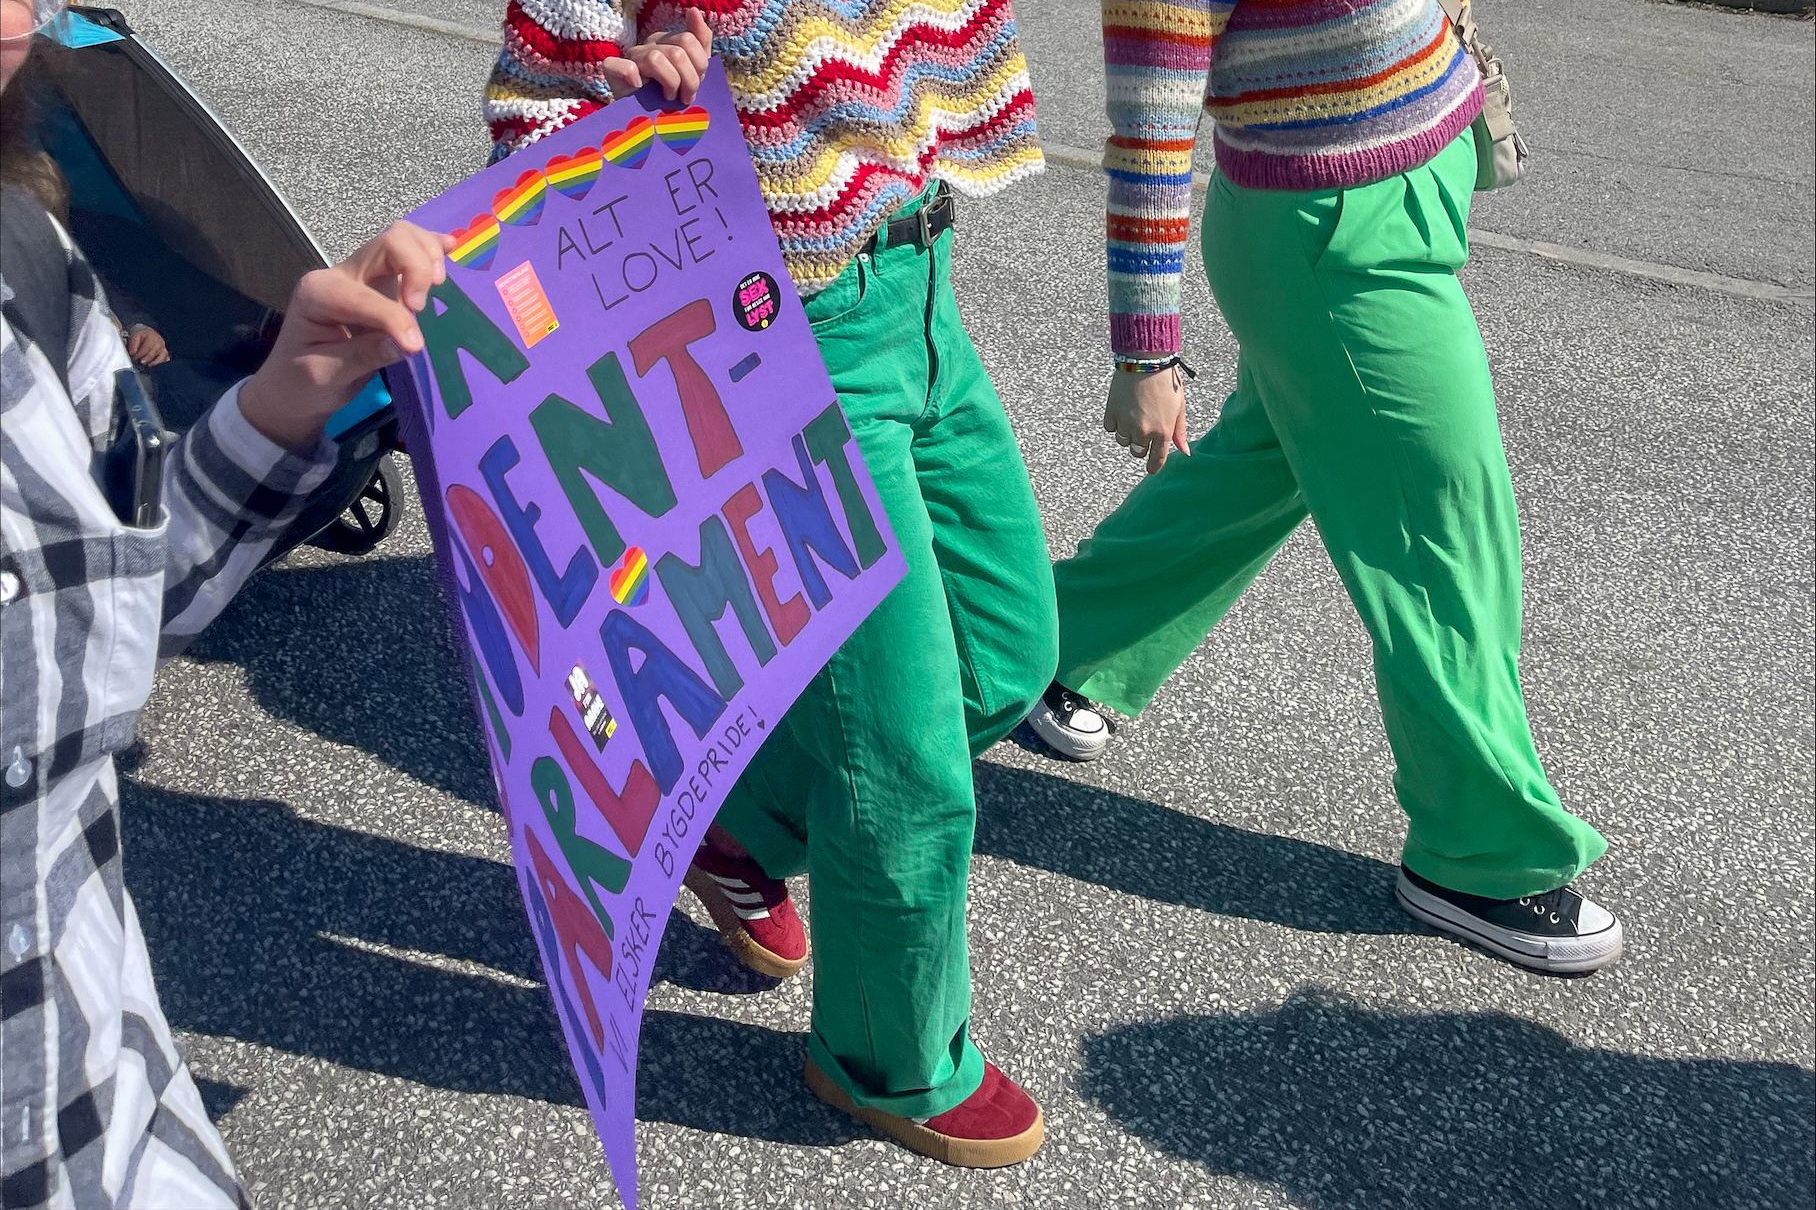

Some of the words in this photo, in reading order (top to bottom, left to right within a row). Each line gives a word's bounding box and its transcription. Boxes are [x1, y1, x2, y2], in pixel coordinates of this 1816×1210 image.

[558, 195, 629, 271] ALT
[664, 158, 719, 217] ER
[591, 207, 734, 312] LOVE!
[739, 277, 770, 307] SEX
[745, 299, 774, 327] LYST
[614, 896, 657, 1013] ELSKER
[653, 704, 766, 880] BYGDEPRIDE!
